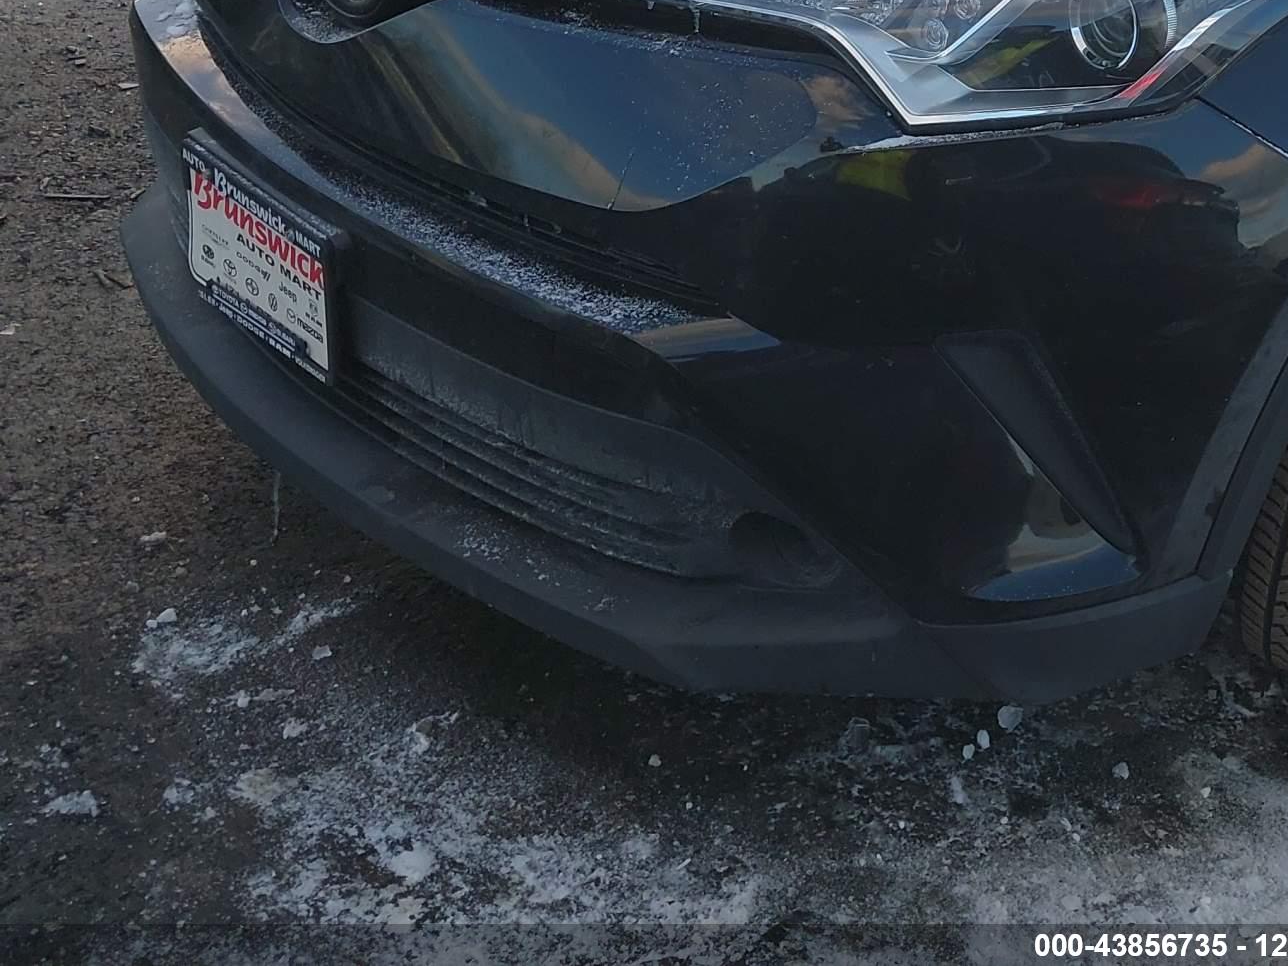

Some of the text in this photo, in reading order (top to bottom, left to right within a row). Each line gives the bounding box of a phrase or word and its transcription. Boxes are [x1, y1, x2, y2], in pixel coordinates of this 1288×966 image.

[182, 147, 321, 258] AUTO Brunswick MART
[237, 233, 275, 267] AUTO
[280, 264, 322, 301] MART
[278, 281, 298, 304] Jeep
